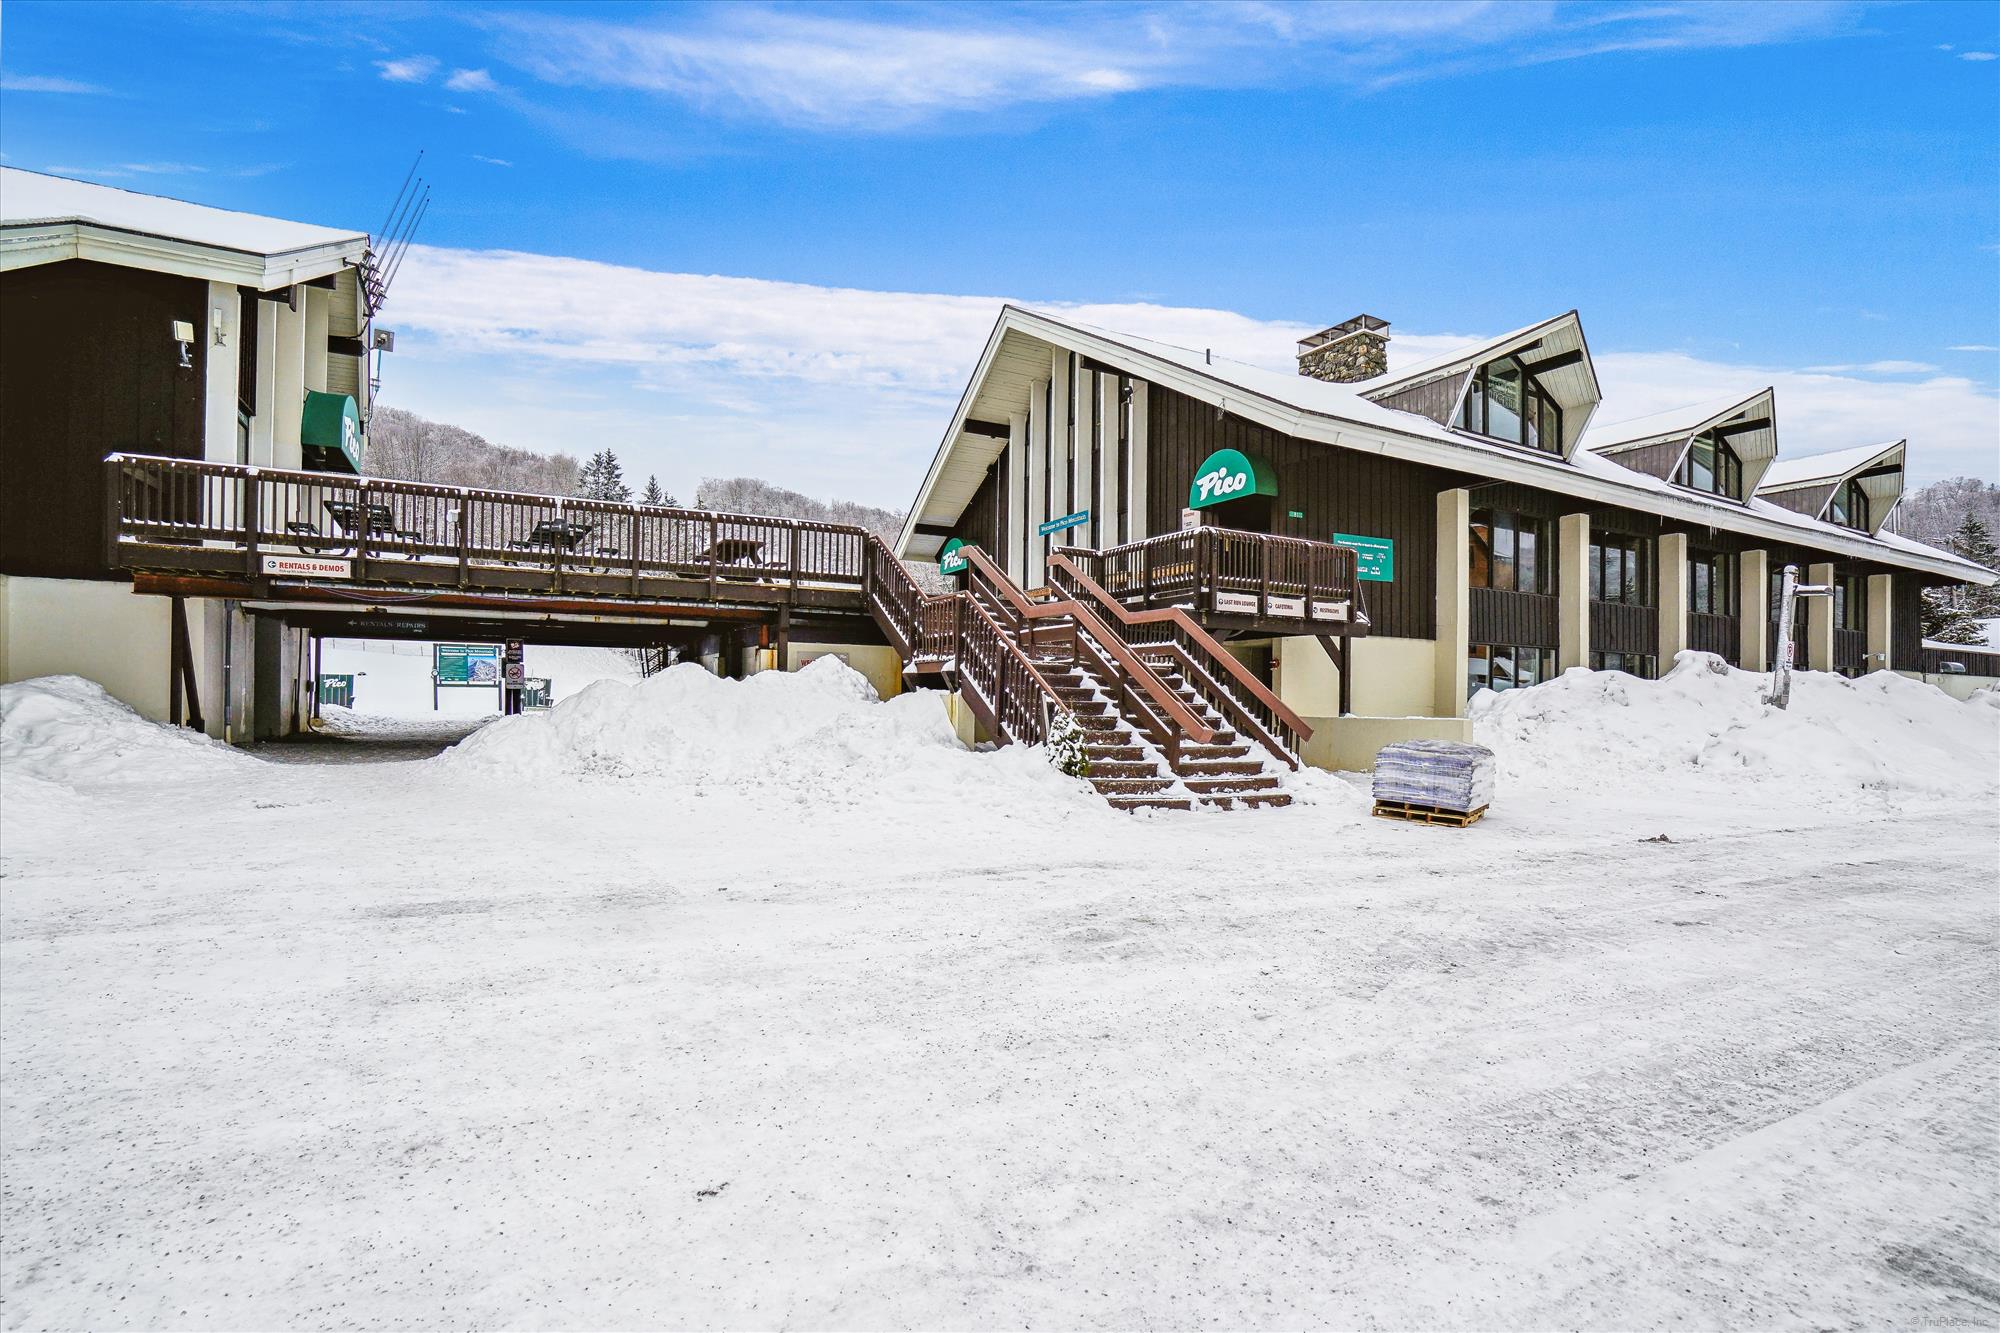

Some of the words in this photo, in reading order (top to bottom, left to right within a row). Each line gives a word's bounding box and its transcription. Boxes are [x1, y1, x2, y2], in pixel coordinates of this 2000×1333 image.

[344, 416, 360, 462] Pico
[1196, 467, 1247, 501] Pico
[279, 562, 311, 570] RENTALS
[319, 564, 345, 572] DEMOS
[323, 678, 347, 688] Pico
